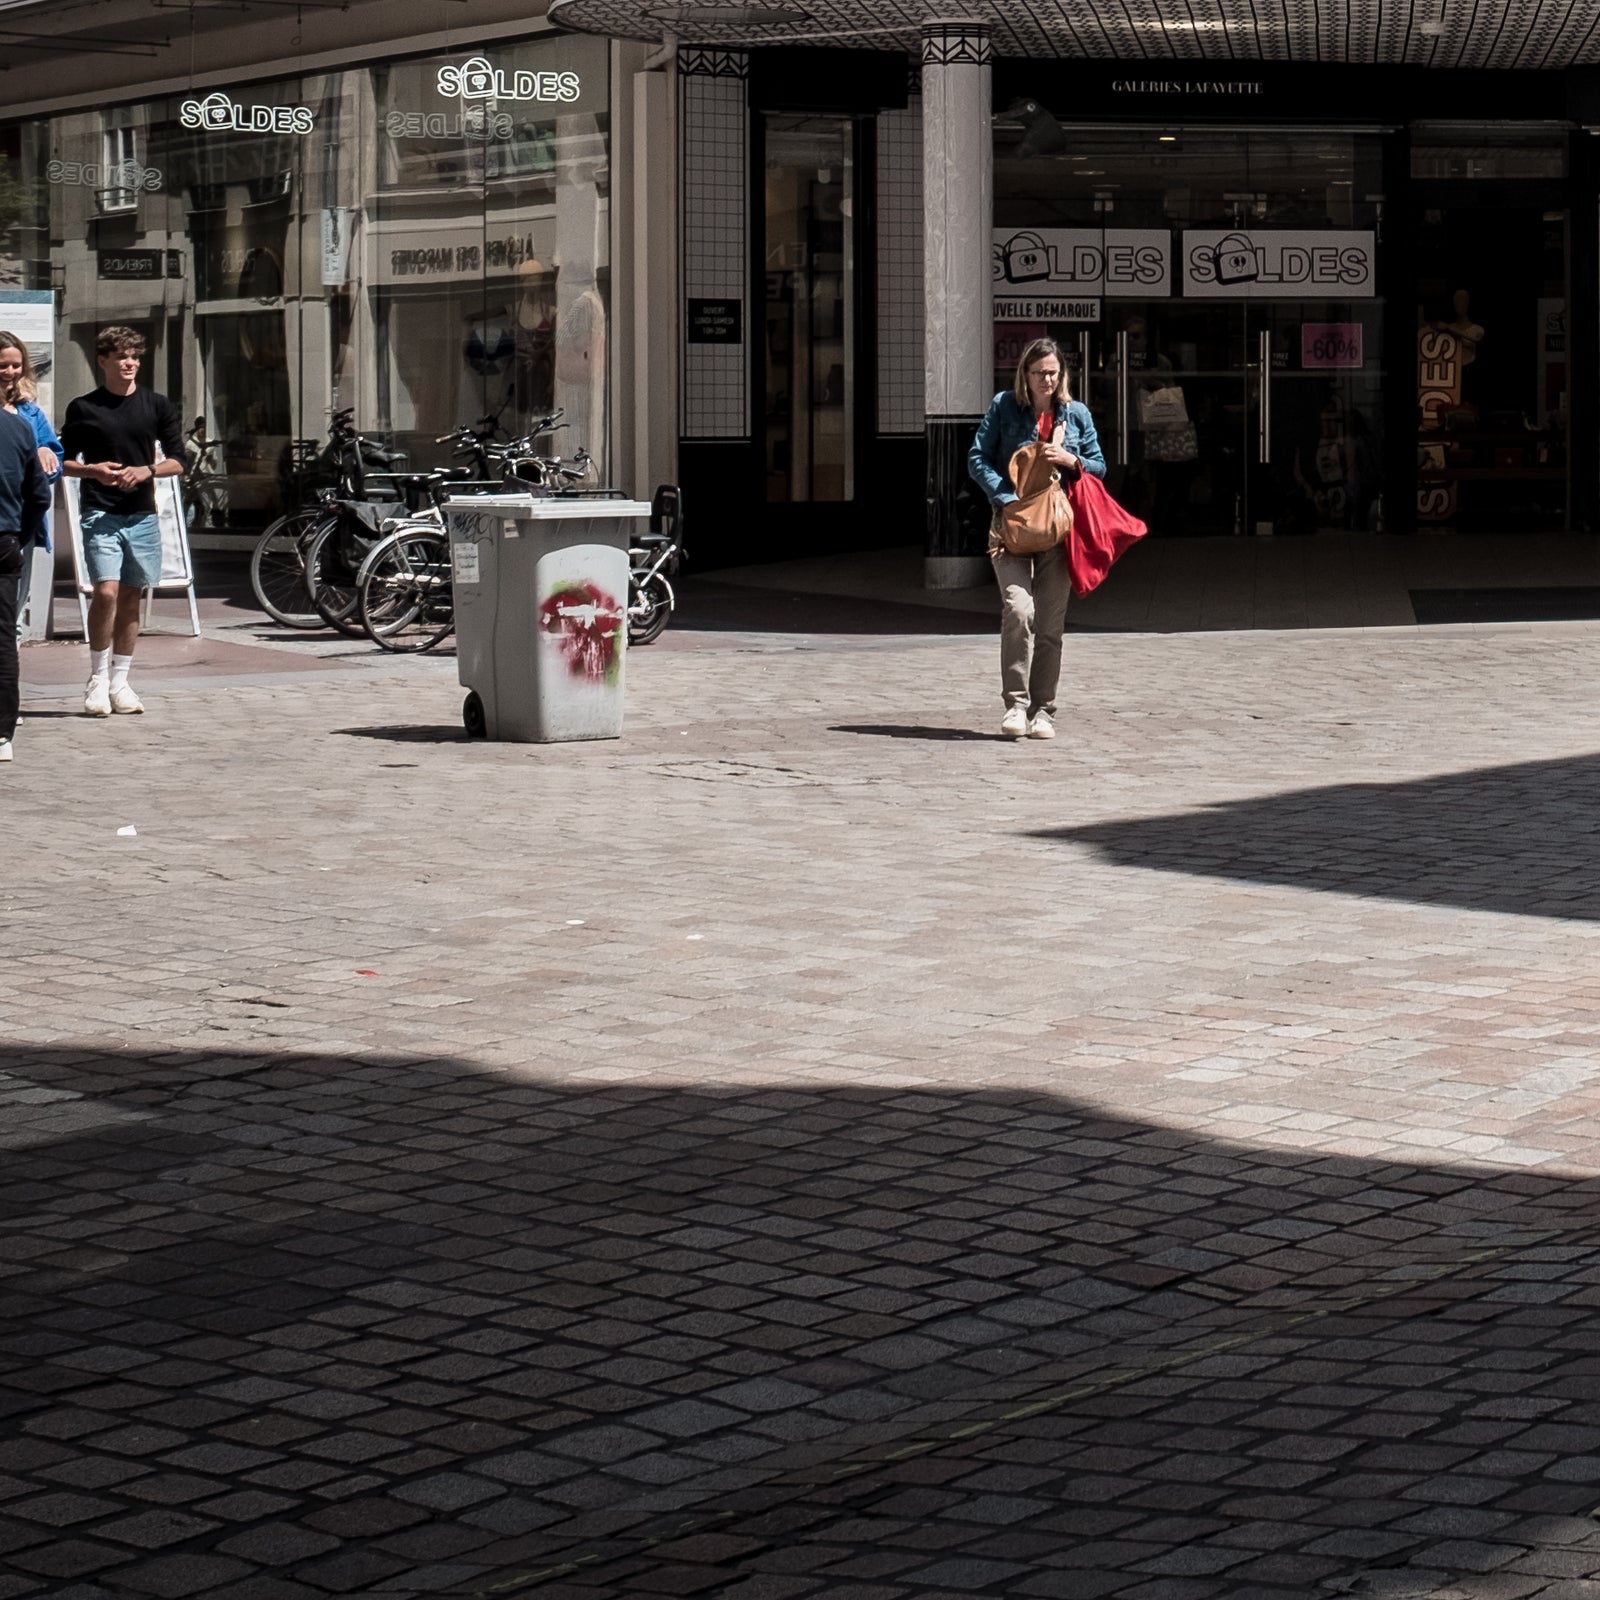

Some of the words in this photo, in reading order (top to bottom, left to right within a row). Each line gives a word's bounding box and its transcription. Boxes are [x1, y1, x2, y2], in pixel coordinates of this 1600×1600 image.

[1111, 79, 1182, 94] GALERIES
[1184, 80, 1264, 95] LAFAYETTE
[1035, 300, 1097, 319] DÉMARQUE
[1306, 339, 1358, 361] -60%
